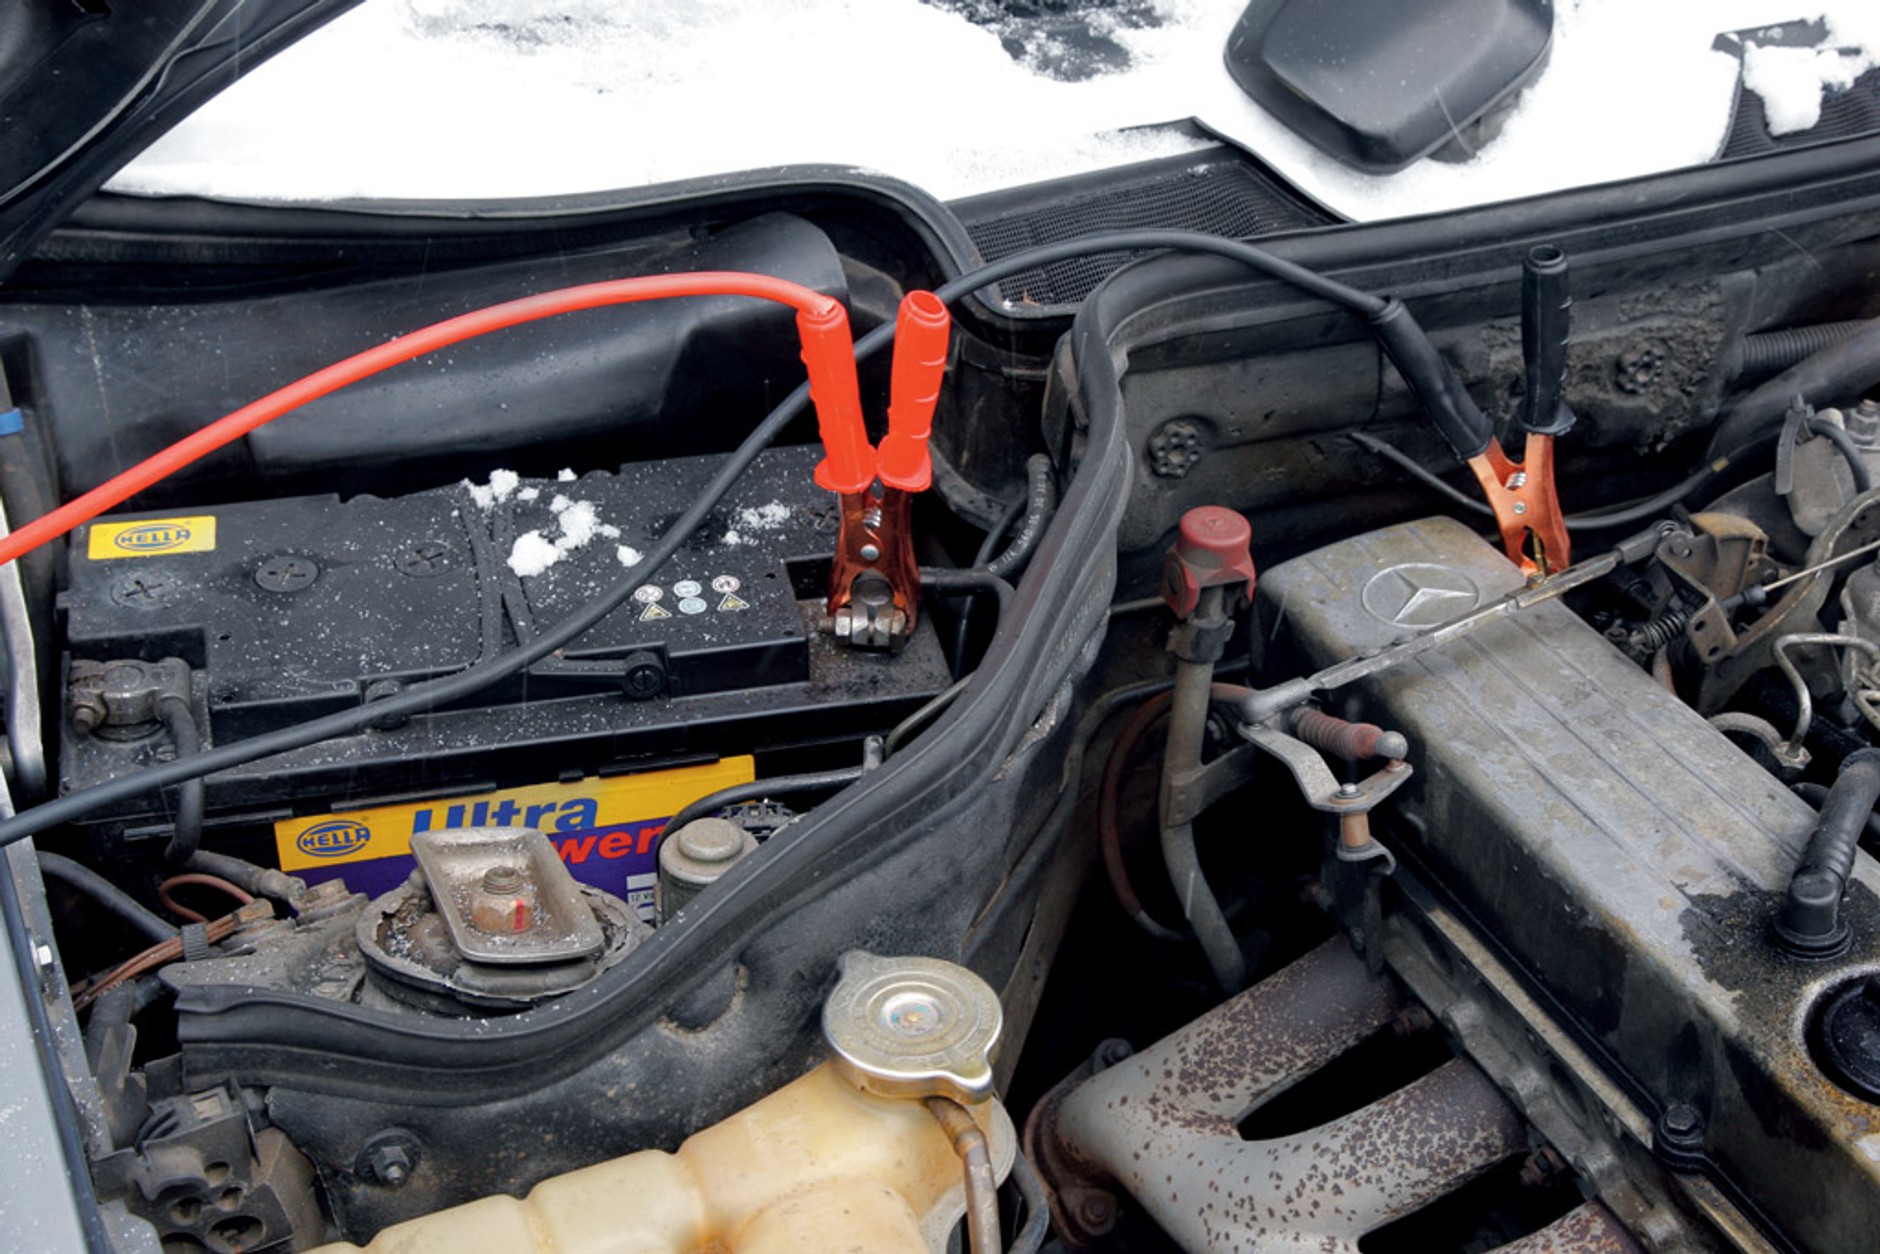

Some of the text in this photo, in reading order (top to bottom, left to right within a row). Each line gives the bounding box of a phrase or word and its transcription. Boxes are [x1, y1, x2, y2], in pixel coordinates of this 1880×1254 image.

[119, 527, 191, 545] HELLA
[413, 798, 598, 834] Ultra
[302, 825, 371, 850] HELLA
[553, 825, 666, 865] wer
